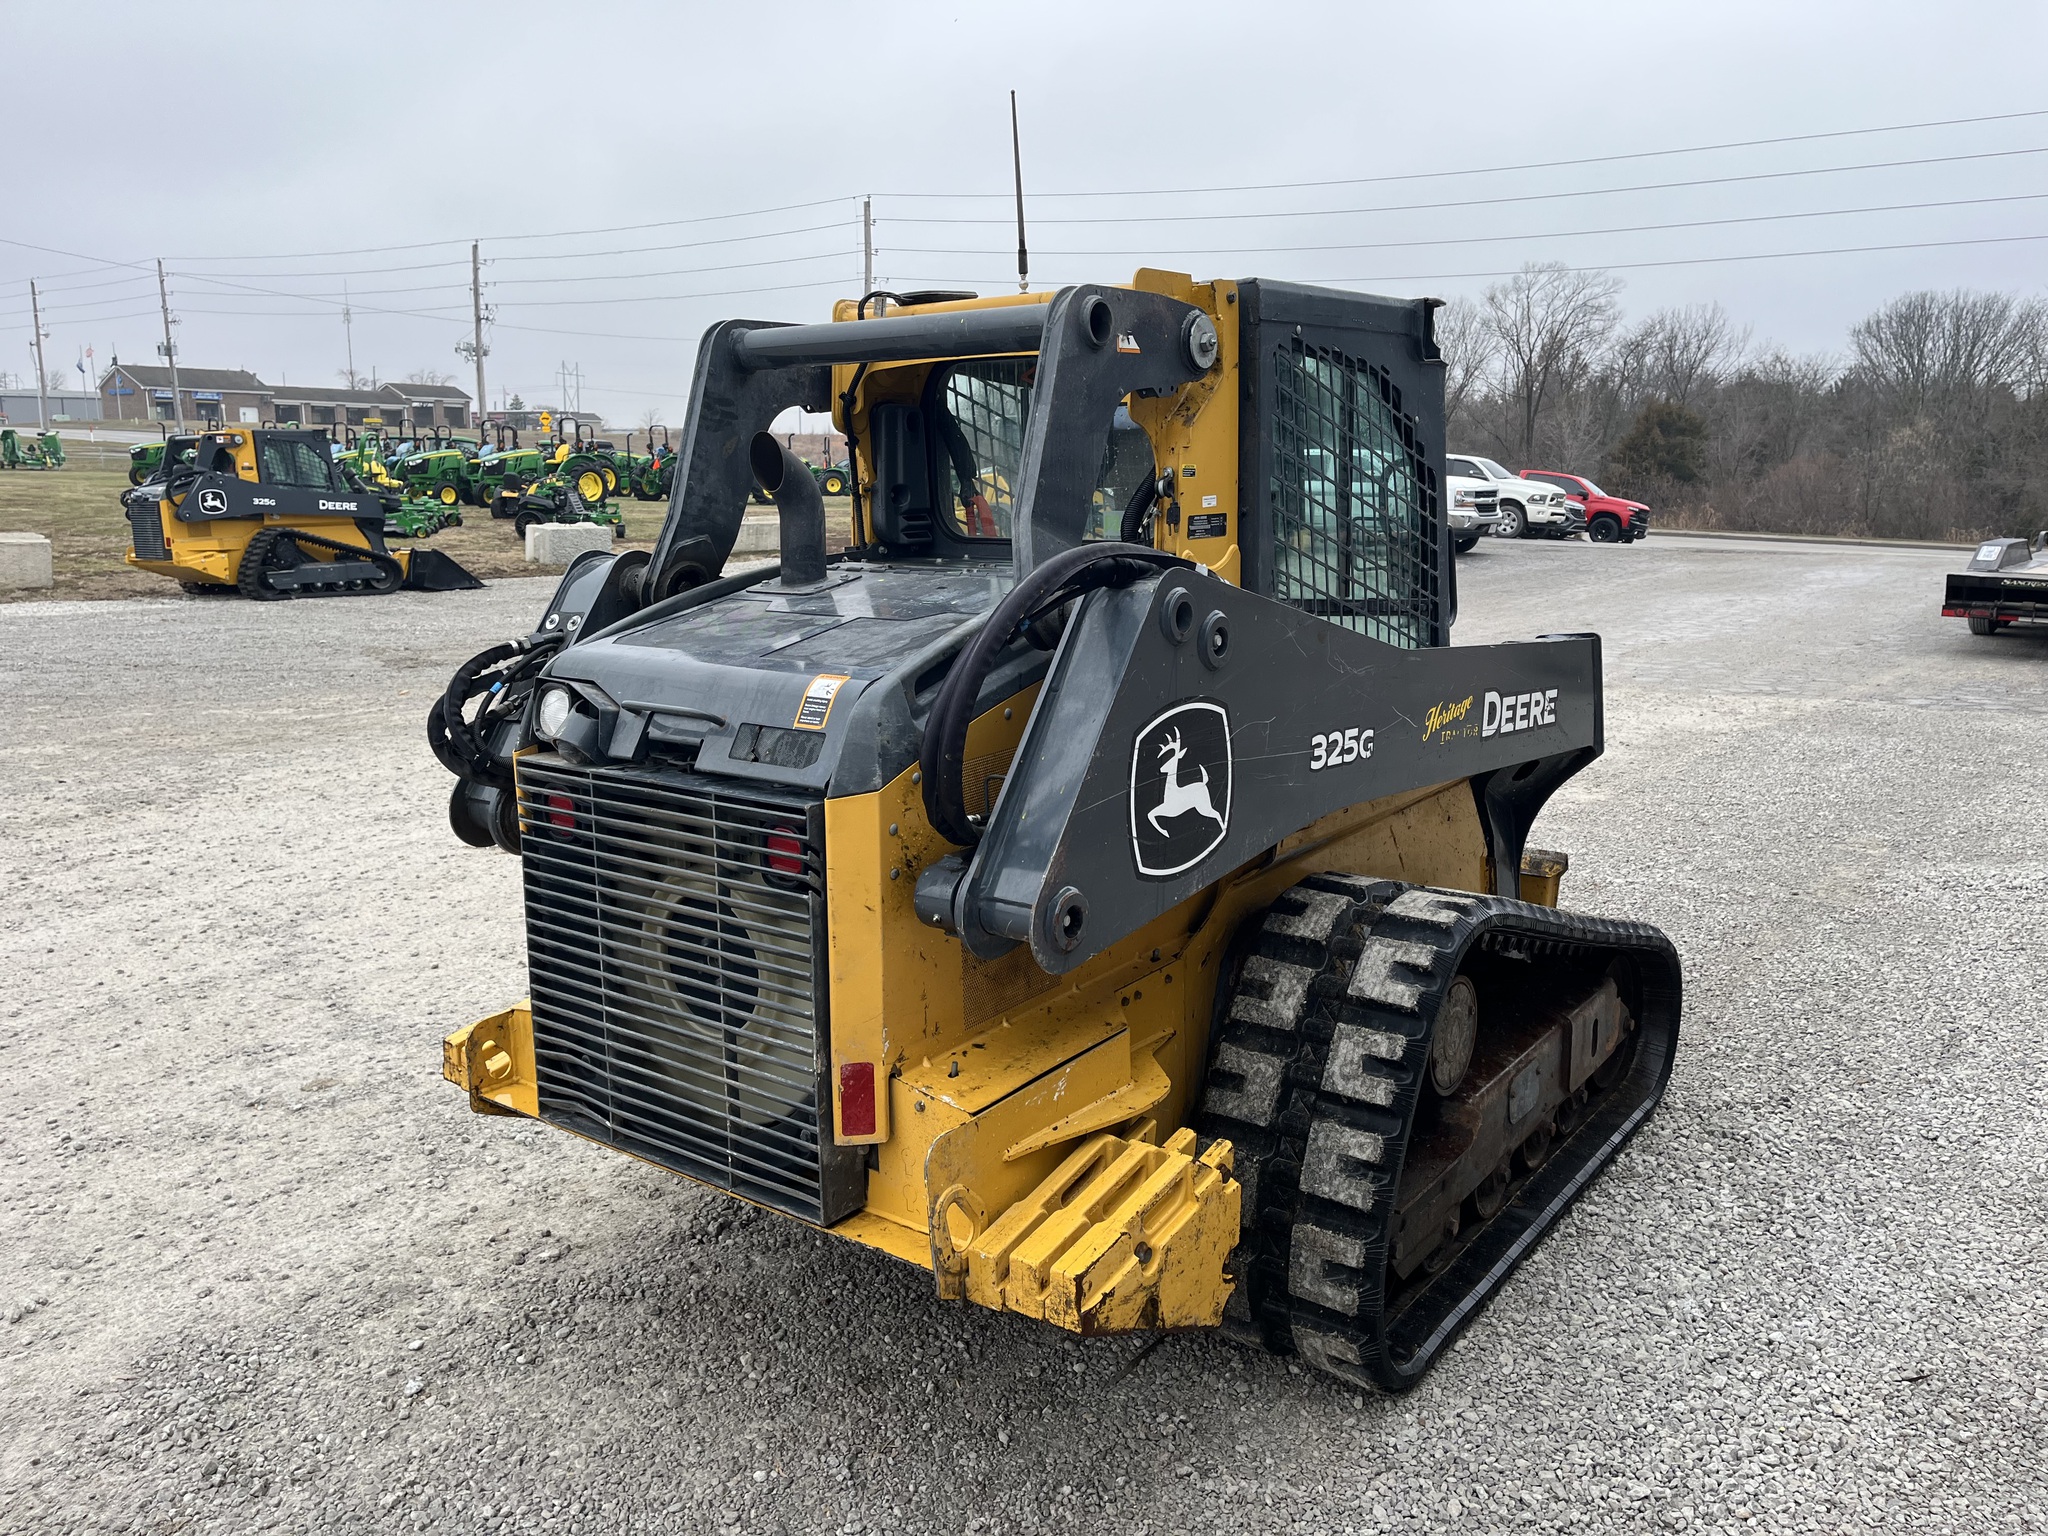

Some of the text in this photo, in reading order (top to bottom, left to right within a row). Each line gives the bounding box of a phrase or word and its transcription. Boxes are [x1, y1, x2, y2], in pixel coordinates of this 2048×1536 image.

[252, 497, 276, 506] 325G
[319, 499, 358, 511] DEERE
[1422, 695, 1474, 742] Heritage
[1482, 688, 1558, 738] DEERE
[1310, 728, 1374, 771] 325G
